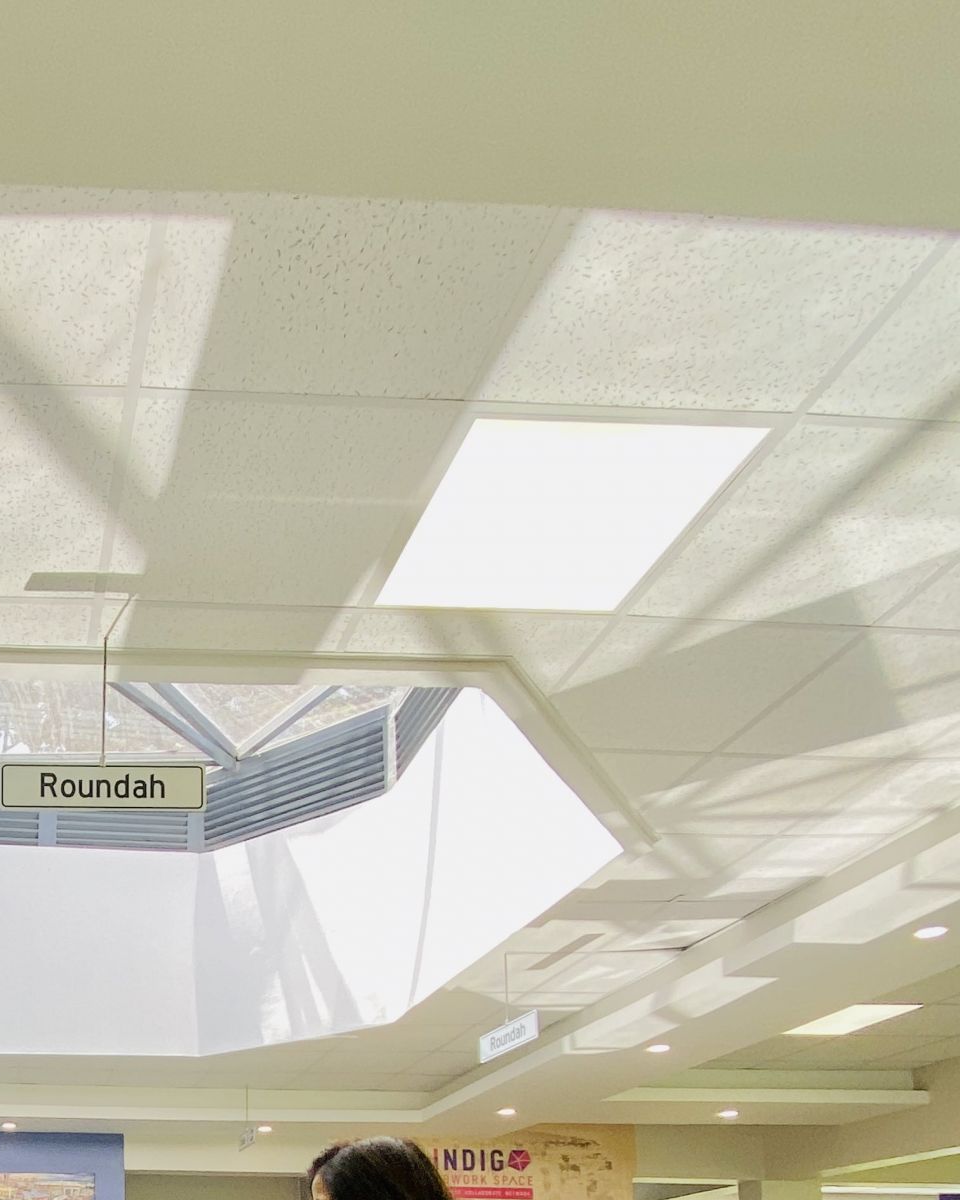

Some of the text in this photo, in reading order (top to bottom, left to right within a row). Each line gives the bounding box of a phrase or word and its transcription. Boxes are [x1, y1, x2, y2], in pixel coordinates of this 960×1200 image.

[39, 772, 166, 799] Roundah
[489, 1022, 527, 1052] Roundah
[493, 1175, 533, 1186] SPACE
